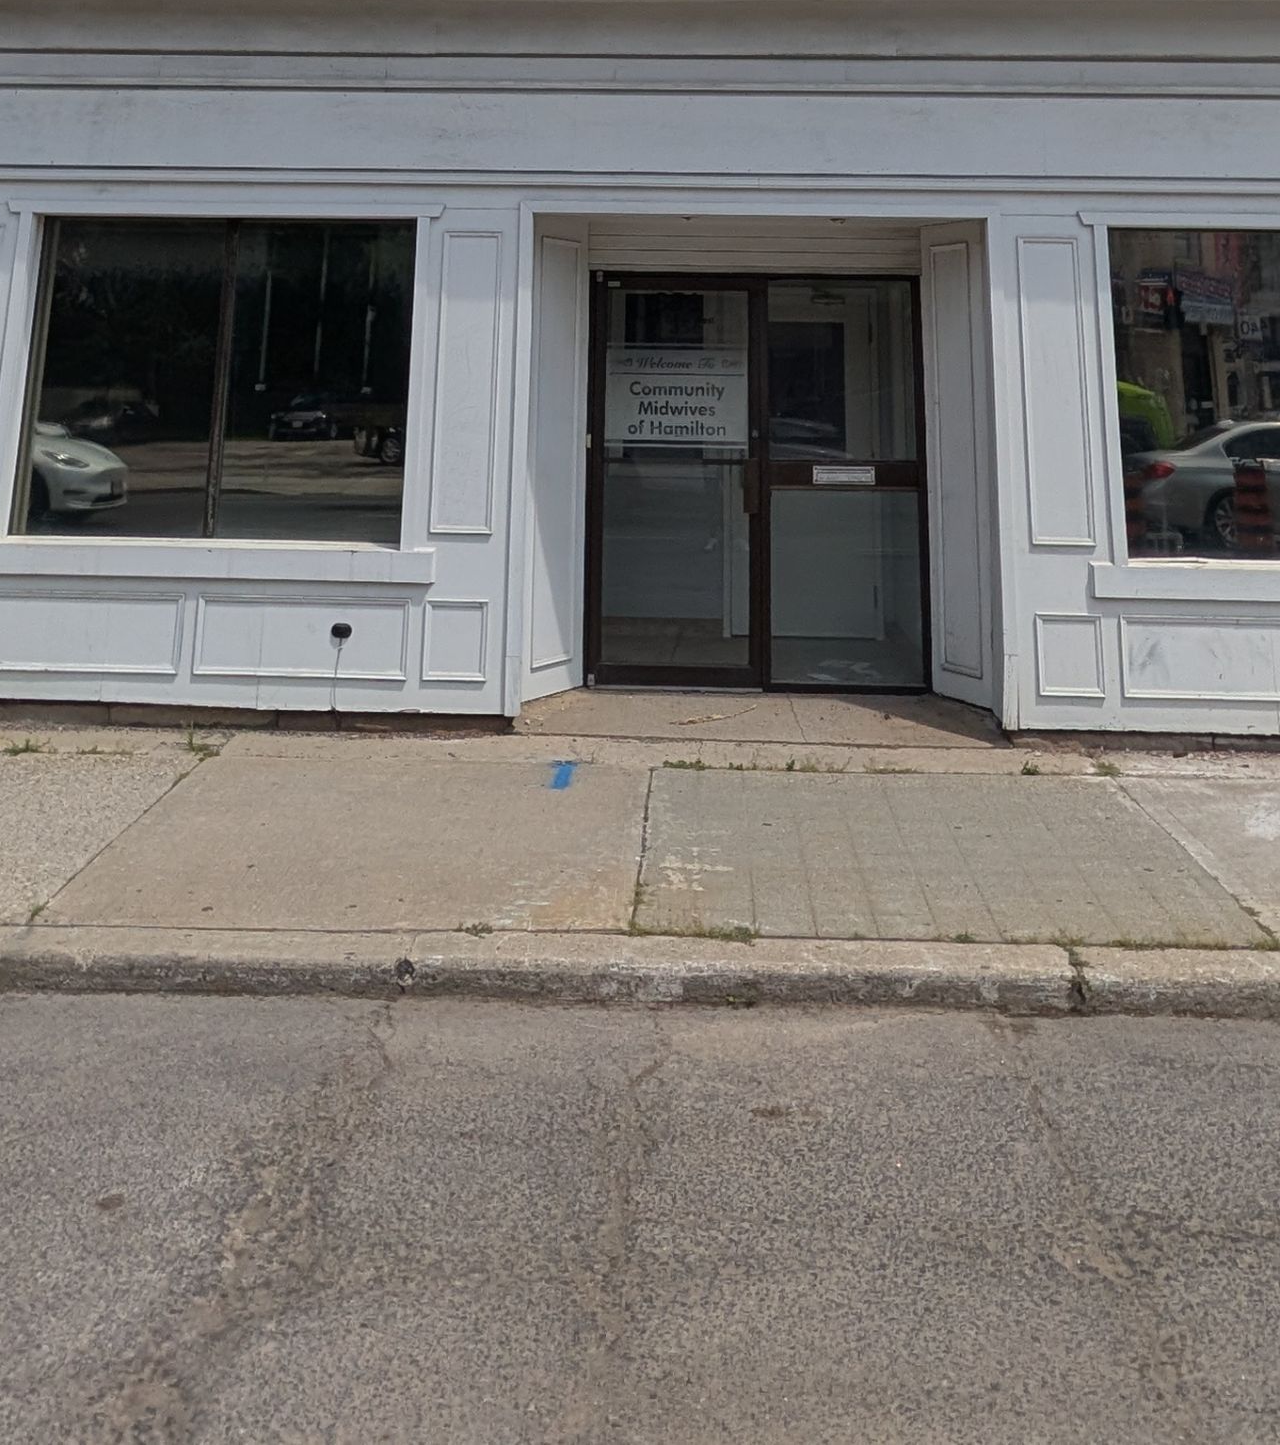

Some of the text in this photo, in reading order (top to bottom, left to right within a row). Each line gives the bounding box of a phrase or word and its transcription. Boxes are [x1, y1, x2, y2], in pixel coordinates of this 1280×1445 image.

[635, 356, 693, 370] Welcome
[629, 381, 725, 400] Community
[637, 400, 717, 417] Midwives
[627, 419, 727, 437] of Hamilton
